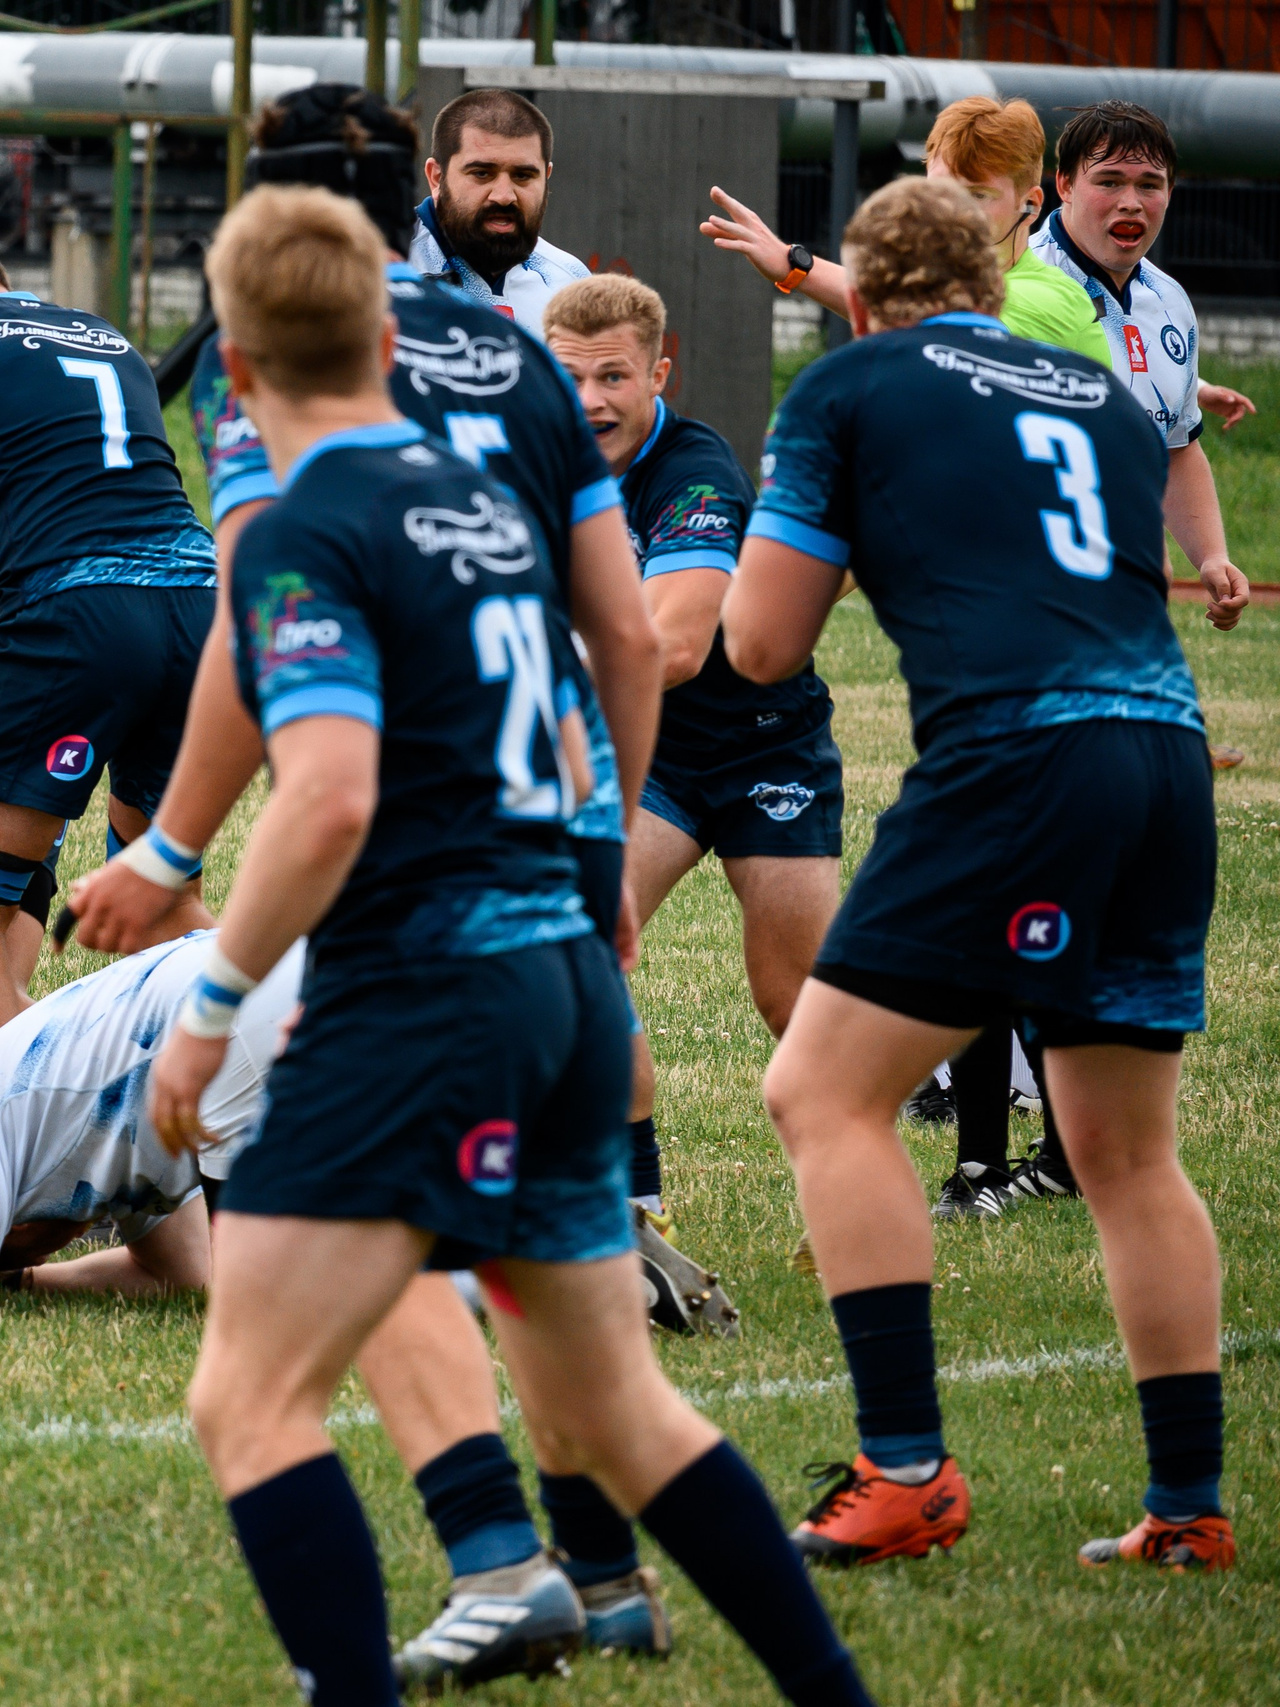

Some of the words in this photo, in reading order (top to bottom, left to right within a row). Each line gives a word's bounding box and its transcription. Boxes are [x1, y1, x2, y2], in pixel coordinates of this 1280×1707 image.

[57, 356, 134, 470] 7
[688, 514, 729, 530] ПРО
[1014, 411, 1115, 580] 3
